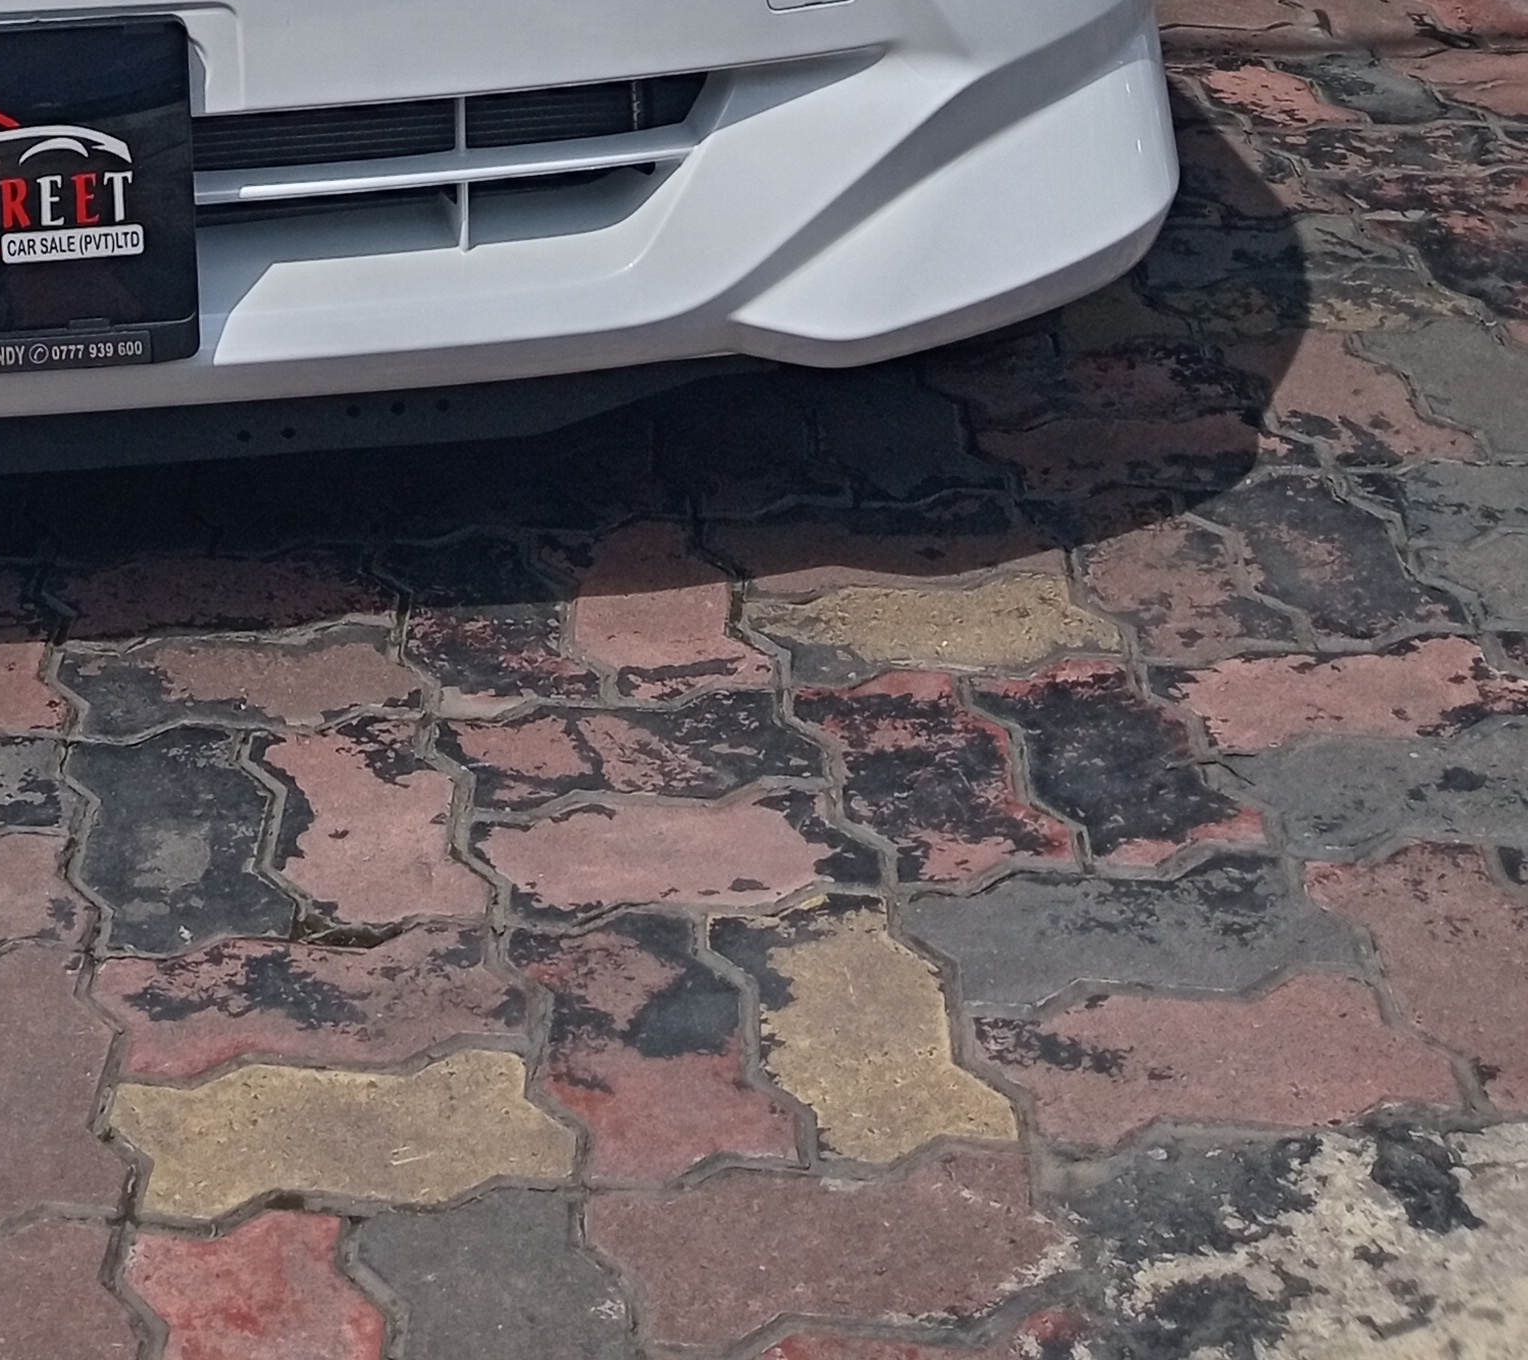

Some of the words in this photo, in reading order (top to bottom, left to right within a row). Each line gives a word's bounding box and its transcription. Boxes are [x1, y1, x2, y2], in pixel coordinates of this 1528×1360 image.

[7, 239, 37, 257] CAR
[40, 235, 77, 255] SALE
[51, 344, 85, 361] 0777
[88, 343, 114, 359] 939
[118, 340, 143, 357] 600
